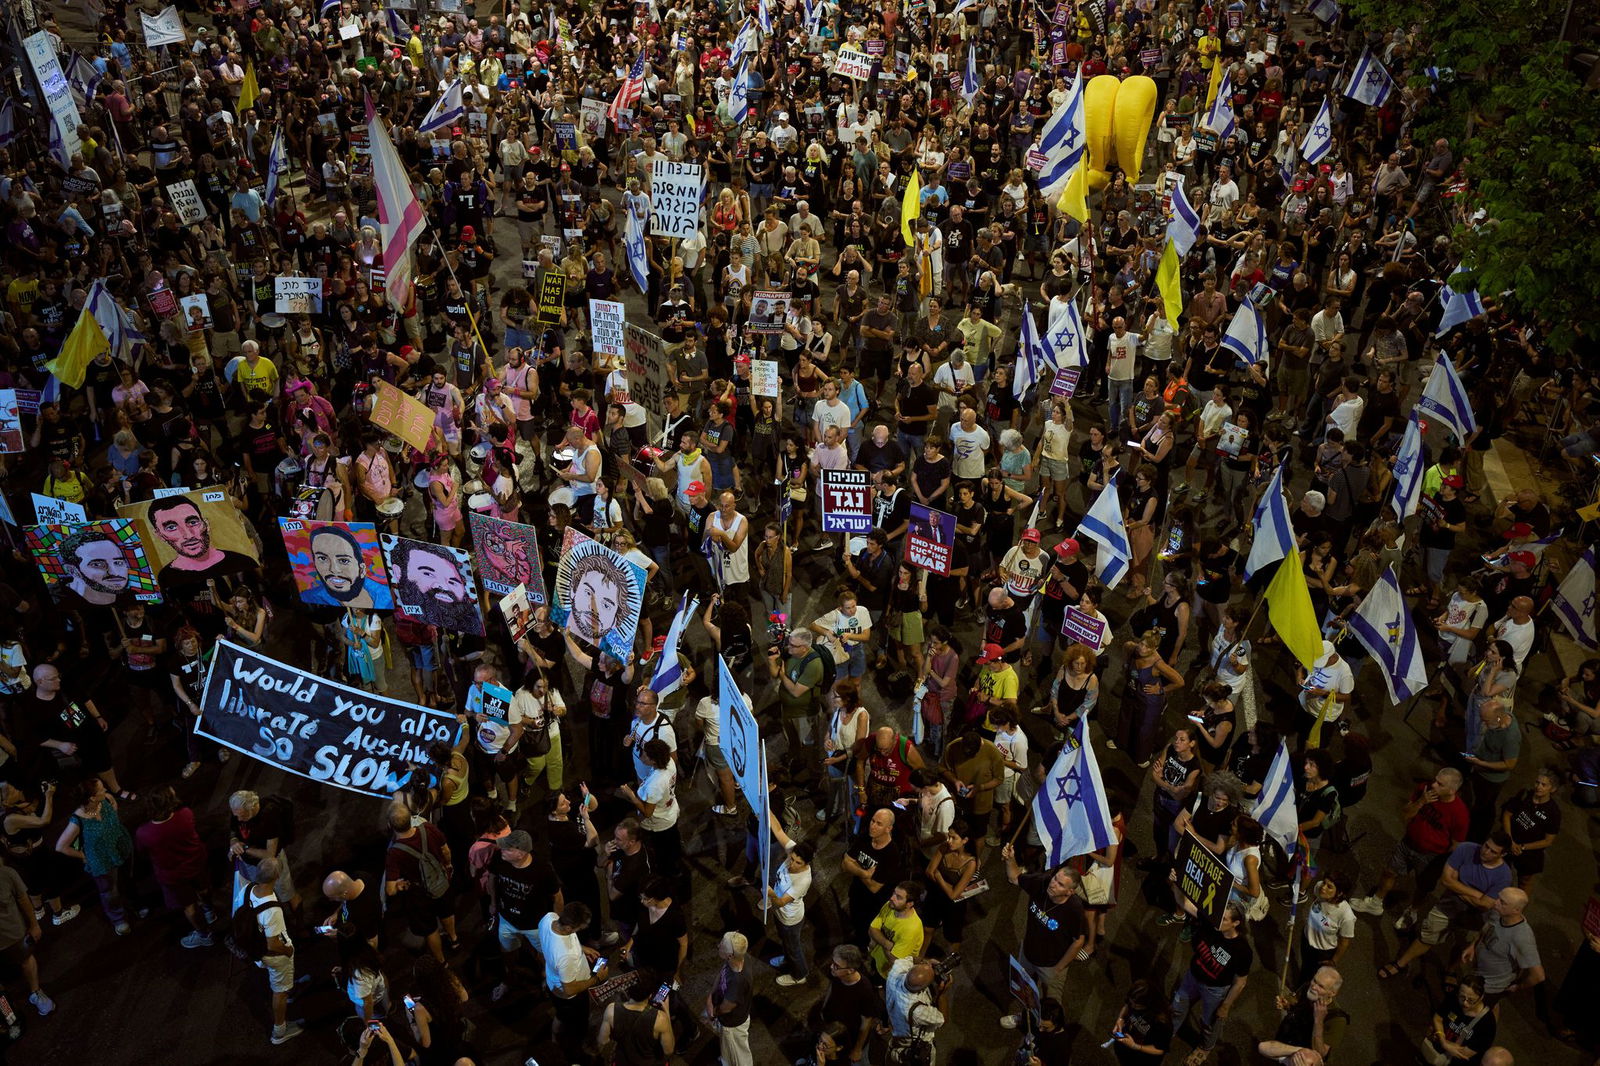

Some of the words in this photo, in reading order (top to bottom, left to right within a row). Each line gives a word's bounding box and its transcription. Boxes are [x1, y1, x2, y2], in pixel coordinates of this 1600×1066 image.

[668, 163, 700, 176] ננצח
[653, 182, 697, 198] ממשלה
[654, 198, 697, 214] בוגדת
[651, 213, 695, 234] בעמה
[282, 281, 299, 290] מתי
[303, 281, 319, 290] עד
[546, 276, 562, 285] WAR
[545, 286, 561, 295] HAS
[543, 296, 556, 304] NO
[829, 472, 866, 483] נתניהו
[205, 493, 222, 501] מתן
[830, 491, 864, 508] נגד
[285, 522, 302, 531] מתן
[827, 515, 870, 530] ישראל
[910, 537, 929, 548] END
[929, 543, 949, 555] THIS
[910, 552, 946, 573] WAR
[485, 580, 510, 594] אחת!
[232, 657, 318, 704] Would
[399, 712, 451, 742] also
[343, 726, 434, 765] Auschw
[309, 745, 413, 793] SLOW
[1185, 858, 1205, 888] DEAL
[1190, 844, 1225, 887] HOSTAGE
[1181, 874, 1202, 904] NOW
